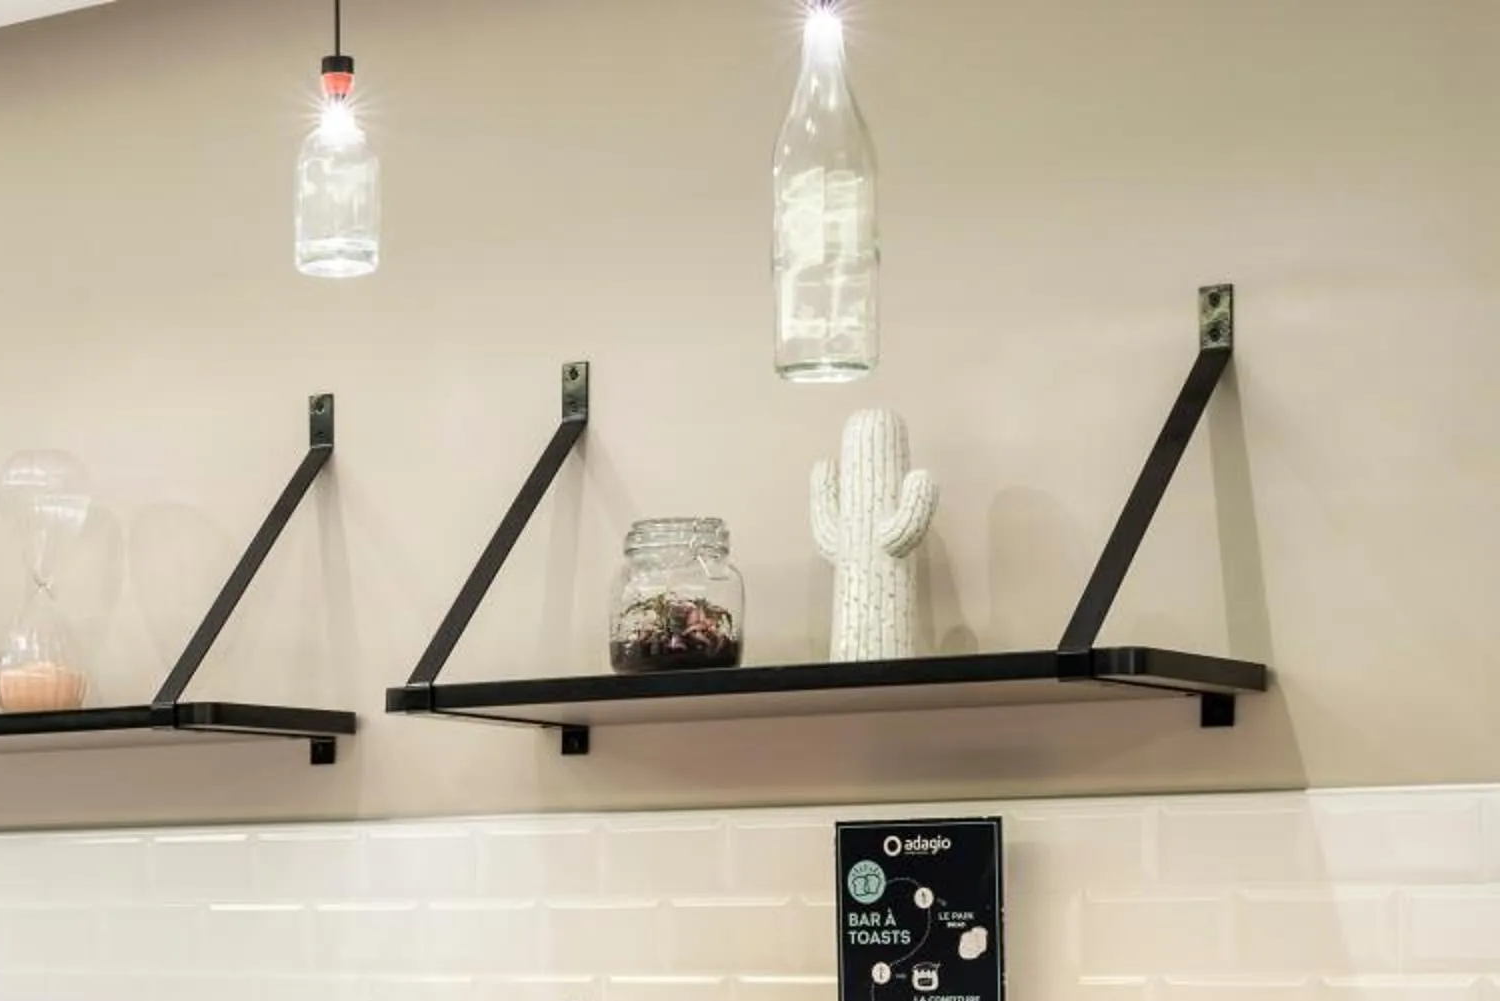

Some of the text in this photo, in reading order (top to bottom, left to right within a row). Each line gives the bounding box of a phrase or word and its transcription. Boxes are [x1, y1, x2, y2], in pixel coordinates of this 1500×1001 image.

[904, 835, 951, 856] adagio
[849, 907, 897, 927] BAR À
[848, 930, 912, 945] TOASTS
